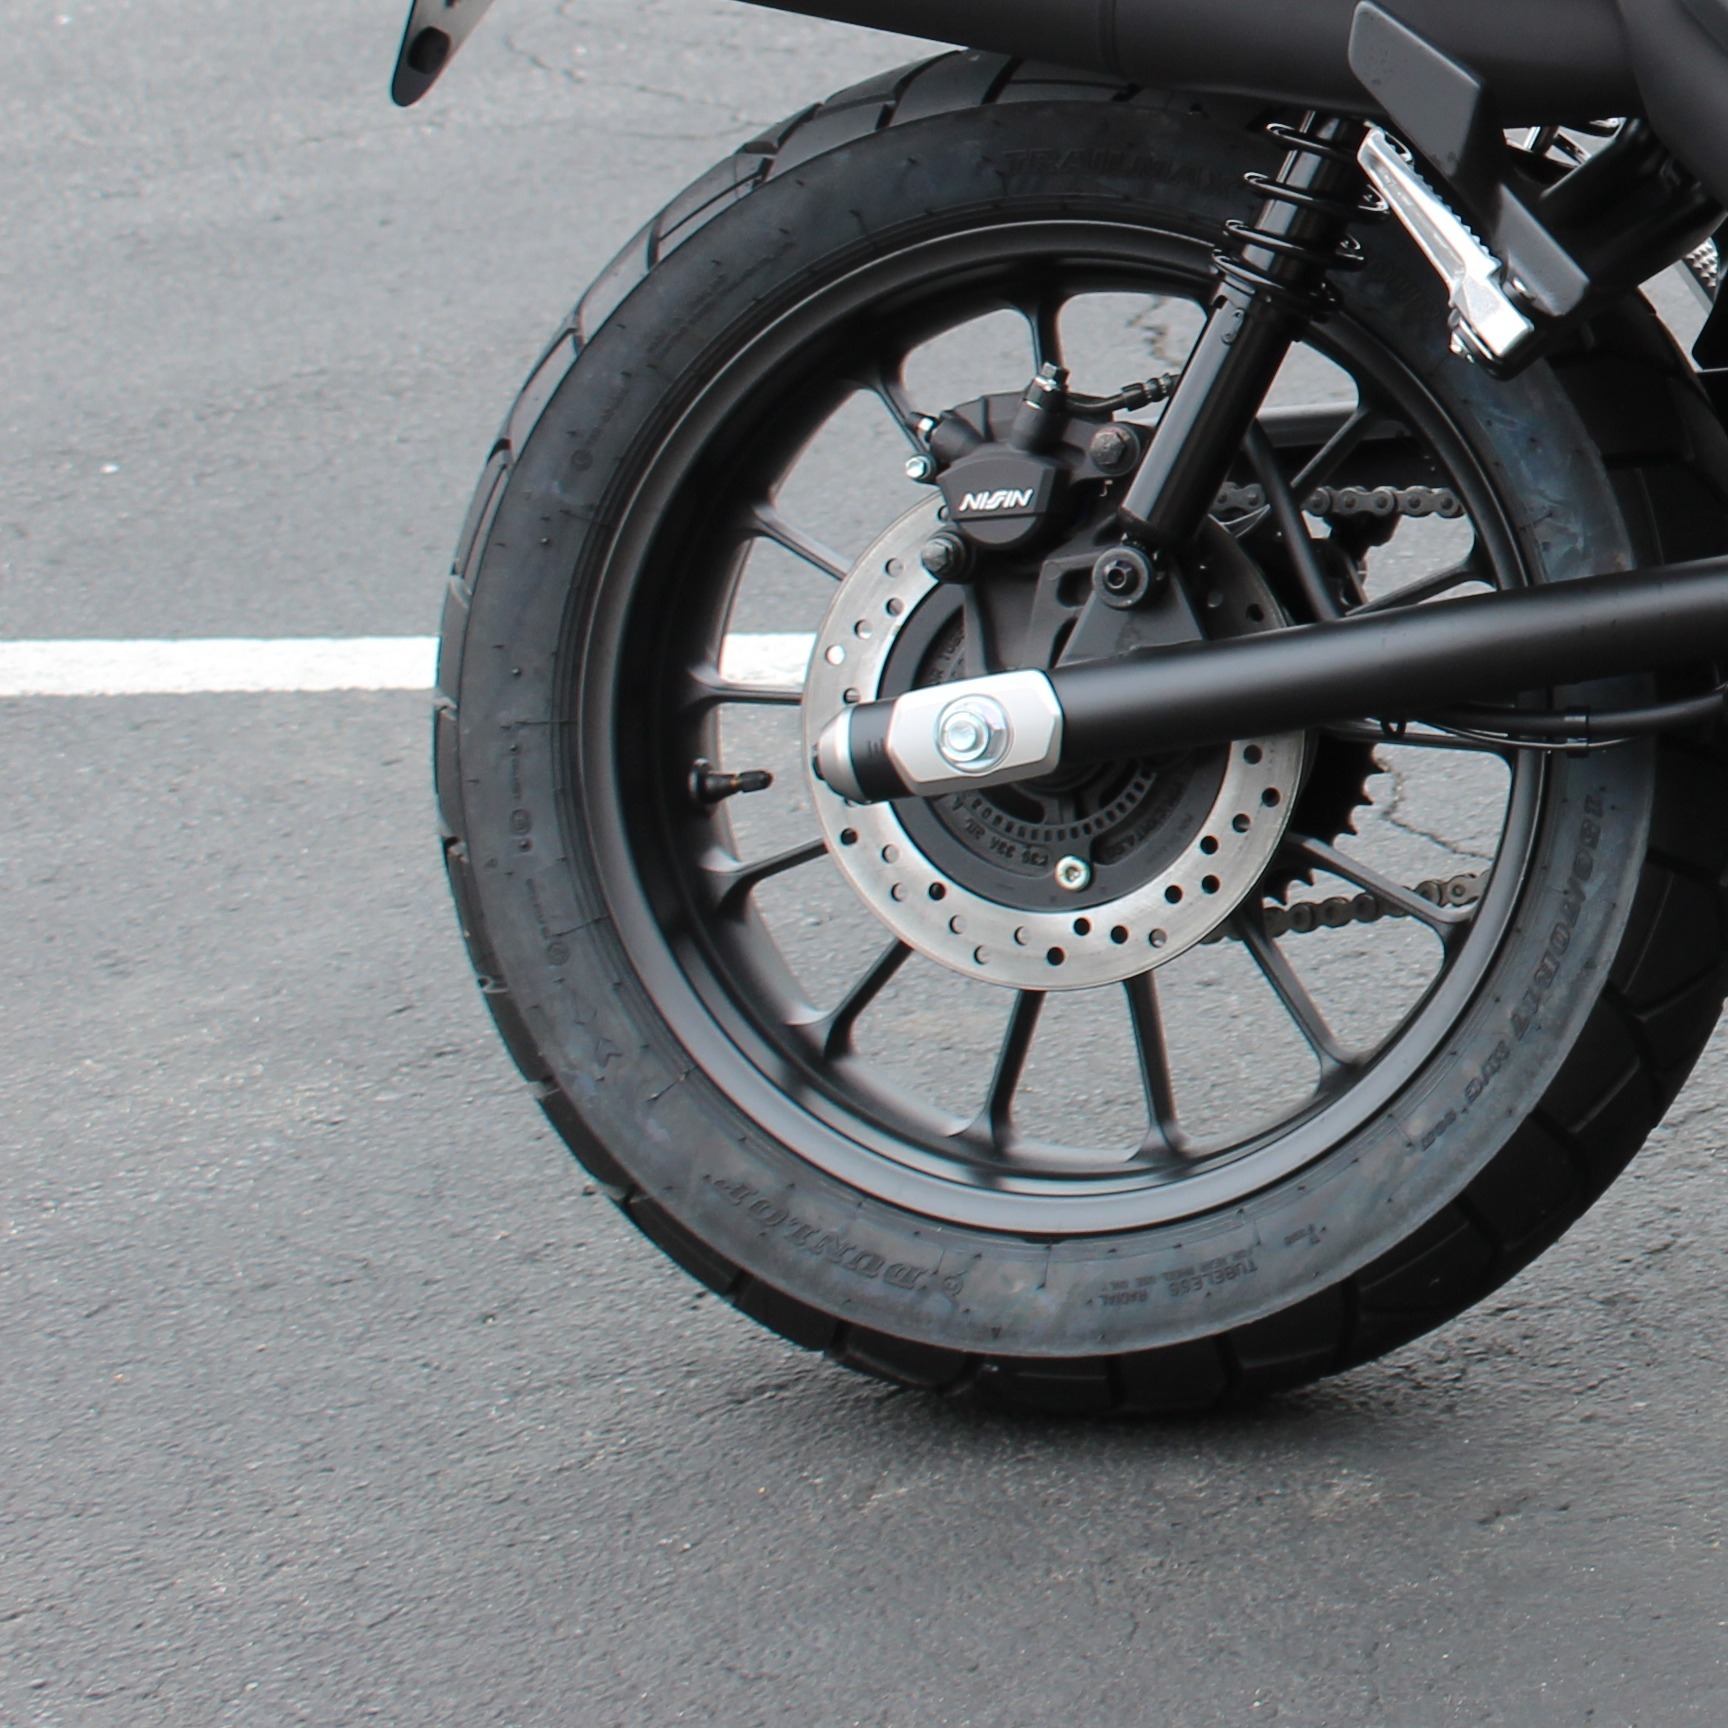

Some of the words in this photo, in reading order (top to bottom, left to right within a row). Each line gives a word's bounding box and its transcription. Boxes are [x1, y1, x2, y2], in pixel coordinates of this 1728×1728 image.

[958, 487, 1034, 513] NISSIN
[713, 1174, 928, 1292] DUNLOP
[1167, 1257, 1260, 1298] TUBELESS
